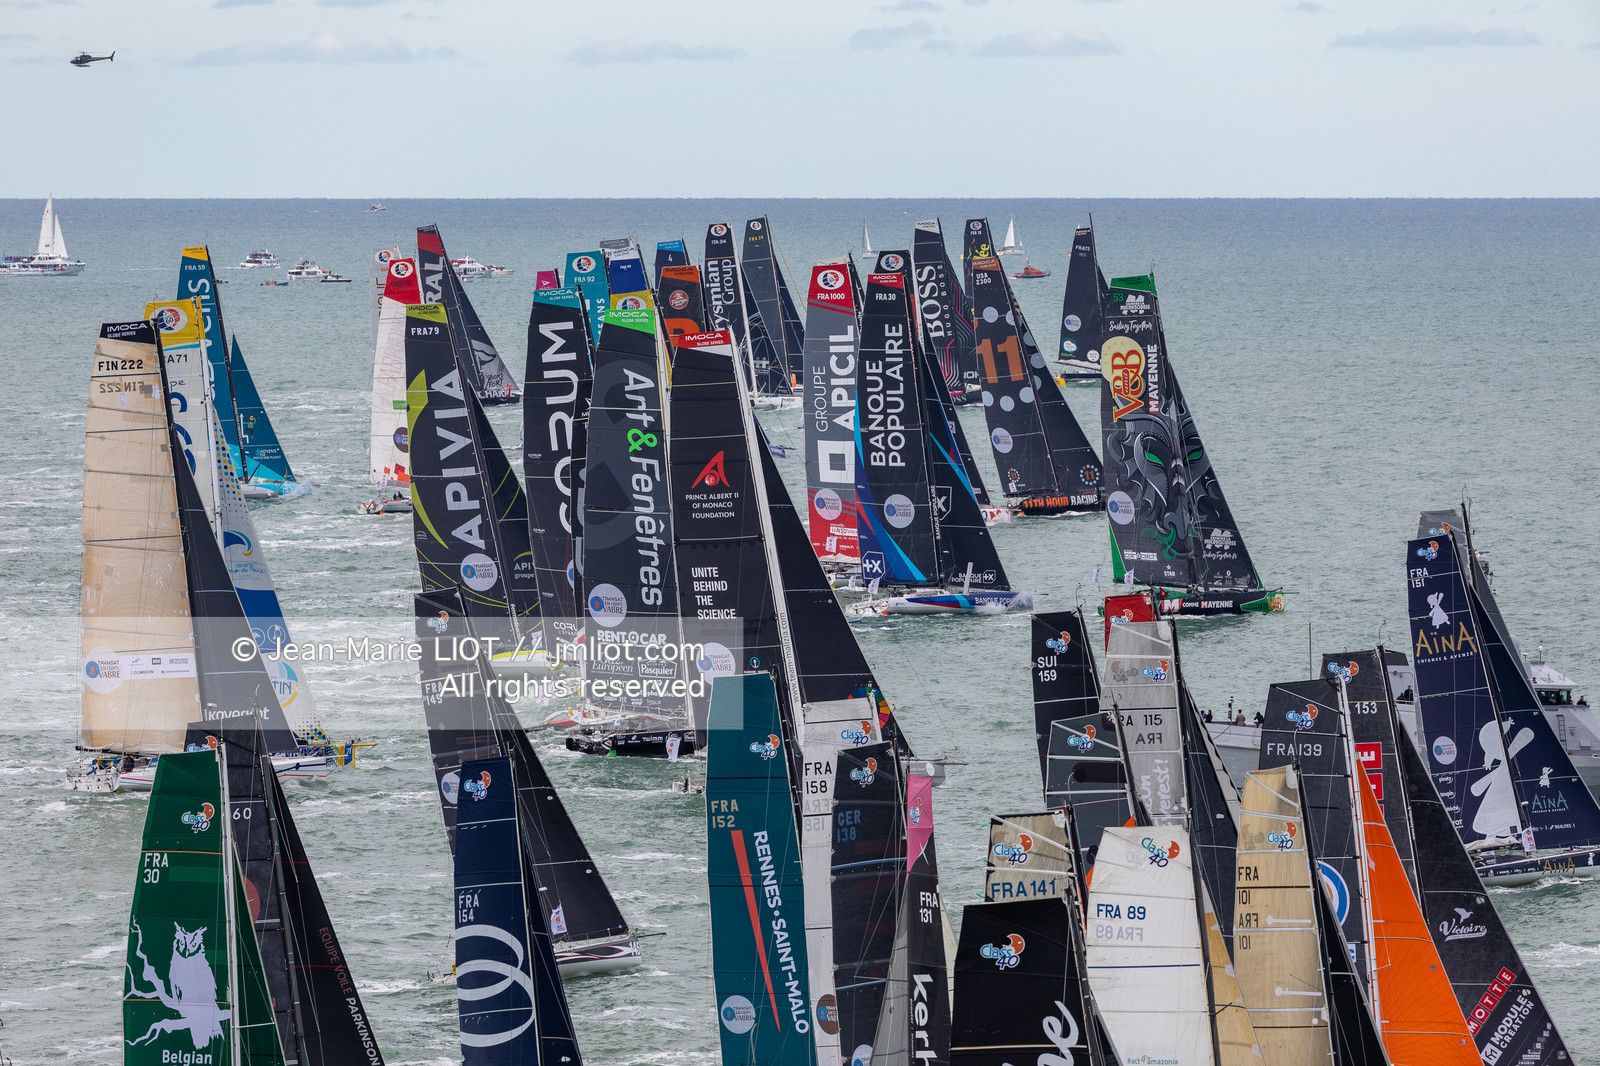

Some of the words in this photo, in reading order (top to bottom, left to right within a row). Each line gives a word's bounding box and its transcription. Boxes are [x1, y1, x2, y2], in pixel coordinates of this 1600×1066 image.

[721, 258, 736, 306] Group
[937, 264, 947, 297] BOSS
[975, 278, 992, 286] 2300
[916, 265, 945, 338] BOSS
[1113, 293, 1124, 302] 53
[942, 304, 953, 337] HUGO
[107, 323, 148, 332] IMOCA
[684, 332, 723, 340] IMOCA
[976, 335, 1024, 384] 11
[828, 325, 857, 432] APICIL
[1147, 344, 1160, 414] MAYENNE
[623, 367, 656, 428] Art
[812, 365, 829, 432] GROUPE
[884, 323, 906, 467] POPULAIRE
[865, 360, 887, 466] BANQUE
[626, 428, 658, 453] &
[430, 369, 486, 550] APIVIA
[1084, 469, 1095, 480] 11
[930, 485, 938, 516] POPULAIRE
[1023, 497, 1045, 509] 11TH
[1046, 496, 1069, 508] HOUR
[1070, 494, 1098, 506] RACING
[692, 511, 735, 519] FOUNDATION
[629, 456, 666, 606] Fenêtres
[1416, 548, 1434, 557] Class
[691, 567, 719, 578] UNITE
[1409, 567, 1429, 578] FRA
[693, 580, 728, 592] BEHIND
[1411, 579, 1425, 589] 151
[695, 595, 713, 606] THE
[1201, 600, 1234, 609] MAYENNE
[603, 606, 624, 614] VABRE
[697, 609, 736, 620] SCIENCE
[1046, 639, 1065, 649] Class
[1054, 644, 1068, 655] 40
[779, 612, 800, 703] www.team-malizia.com
[1037, 656, 1057, 668] SUI
[1450, 651, 1474, 660] AVENIR
[98, 670, 121, 679] VABRE
[640, 663, 674, 677] Pasquier
[711, 664, 733, 672] VABRE
[1141, 667, 1162, 677] Class
[1327, 662, 1350, 676] Class
[1038, 670, 1057, 682] 159
[1152, 673, 1167, 683] 40
[1354, 702, 1378, 714] 153
[1144, 714, 1163, 726] 115
[1286, 711, 1309, 722] Class
[1297, 719, 1314, 730] 40
[841, 729, 863, 740] Class
[853, 735, 869, 747] 40
[750, 742, 773, 753] Class
[1067, 736, 1089, 747] Class
[1078, 741, 1094, 753] 40
[760, 749, 778, 760] 40
[804, 760, 832, 776] FRA
[850, 769, 869, 781] Class
[860, 774, 875, 787] 40
[464, 780, 484, 792] Class
[805, 780, 828, 795] 158
[472, 788, 487, 801] 40
[711, 799, 740, 813] FRA
[182, 811, 205, 824] Class
[712, 815, 736, 828] 152
[837, 810, 861, 826] GER
[191, 820, 210, 833] 40
[836, 827, 857, 843] 138
[1267, 831, 1289, 843] Class
[993, 843, 1022, 857] Class
[1141, 837, 1168, 859] Class
[1277, 839, 1294, 852] 40
[144, 853, 169, 868] FRA
[1008, 852, 1028, 865] 40
[1149, 853, 1170, 868] 40
[143, 869, 160, 884] 30
[1238, 866, 1260, 881] FRA
[458, 894, 480, 908] FRA
[919, 892, 939, 908] FRA
[1237, 889, 1251, 905] 101
[458, 908, 475, 923] 154
[919, 909, 933, 923] 131
[1096, 903, 1122, 919] FRA
[1127, 906, 1147, 920] 89
[753, 831, 783, 909] RENNES
[771, 918, 810, 1034] SAINT-MALO
[1438, 918, 1486, 936] Victoire
[980, 943, 1013, 959] Class
[995, 954, 1021, 970] 40
[318, 926, 340, 964] EQUIPE
[334, 964, 353, 996] VOILE
[345, 997, 382, 1066] PARKINSON
[1467, 971, 1512, 1033] MOTTE
[734, 1013, 755, 1022] VABRE
[1489, 994, 1528, 1046] MODULE
[1499, 1000, 1536, 1049] CREATION
[162, 1049, 212, 1065] Belgian
